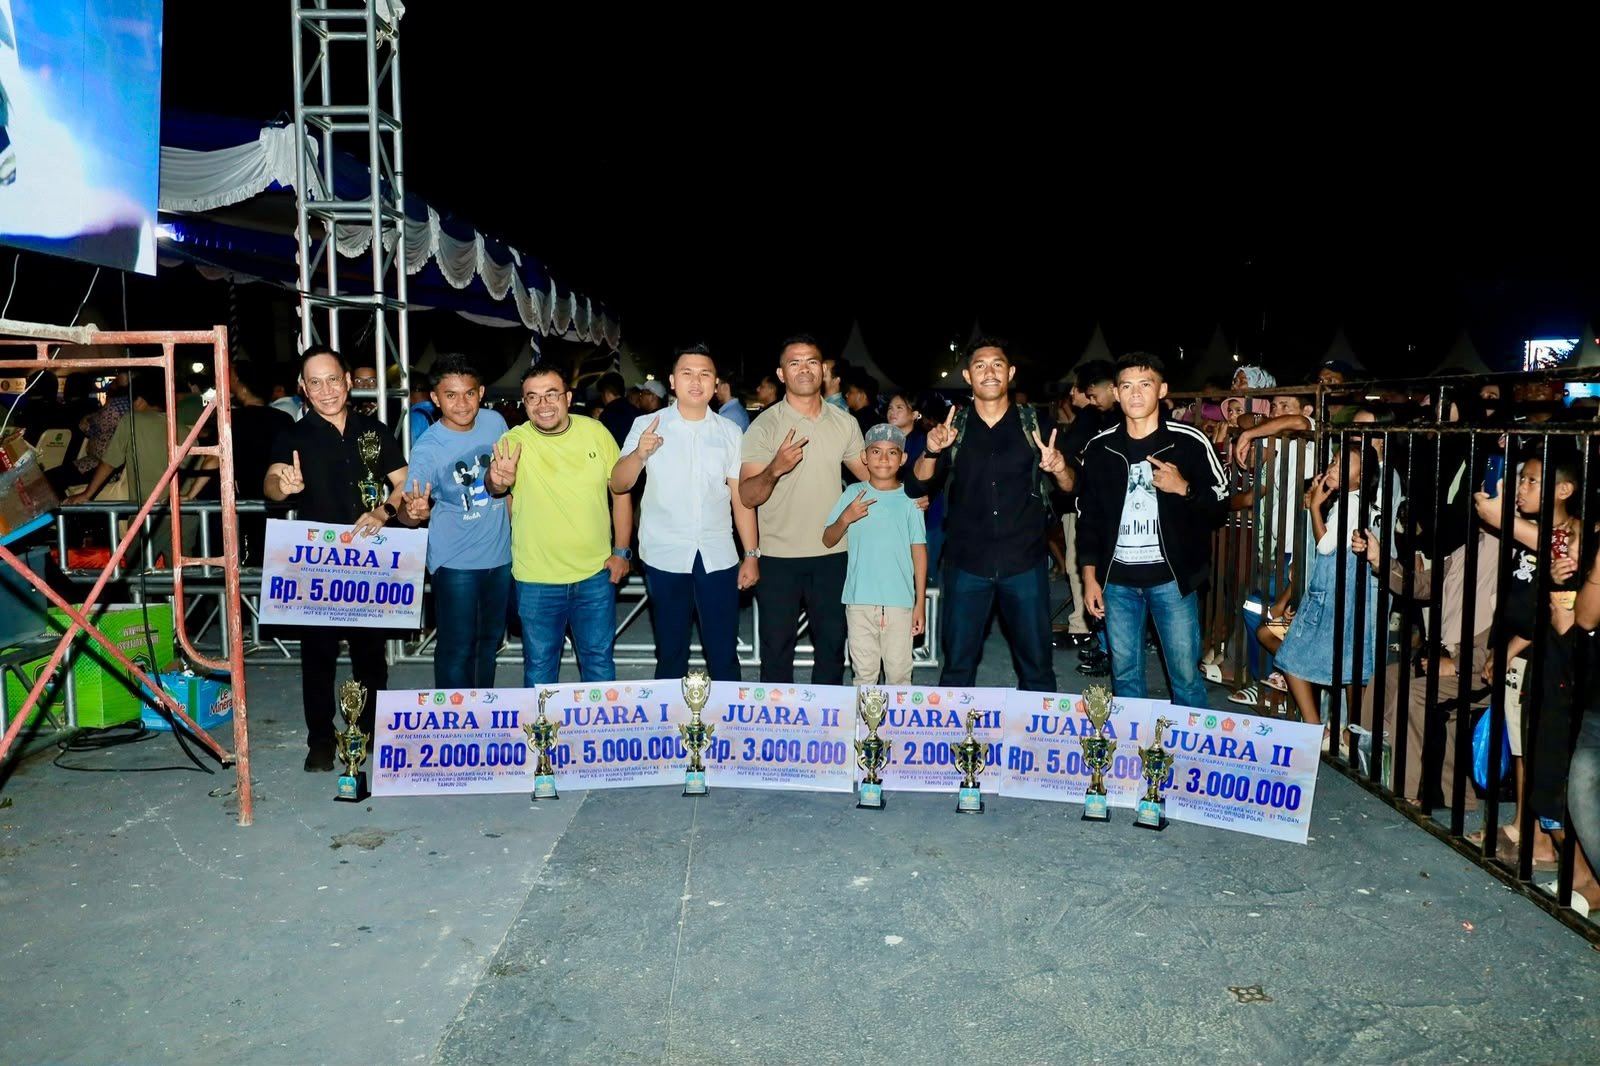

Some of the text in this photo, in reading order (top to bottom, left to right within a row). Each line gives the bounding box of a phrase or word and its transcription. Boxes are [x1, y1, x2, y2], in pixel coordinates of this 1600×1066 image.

[289, 545, 400, 569] JUARA I
[270, 576, 414, 605] Rp. 5.000.000
[220, 688, 229, 700] Le
[388, 710, 519, 730] JUARA III
[560, 703, 669, 727] JUARA I
[722, 704, 840, 727] JUARA II
[1129, 721, 1140, 740] I
[380, 743, 526, 771] Rp. 2.000.000
[583, 736, 688, 764] 5.000.000
[705, 736, 846, 765] Rp. 3.000.000
[1008, 746, 1039, 775] Rp.
[1164, 729, 1293, 768] JUARA II
[1186, 768, 1301, 811] 3.000.000
